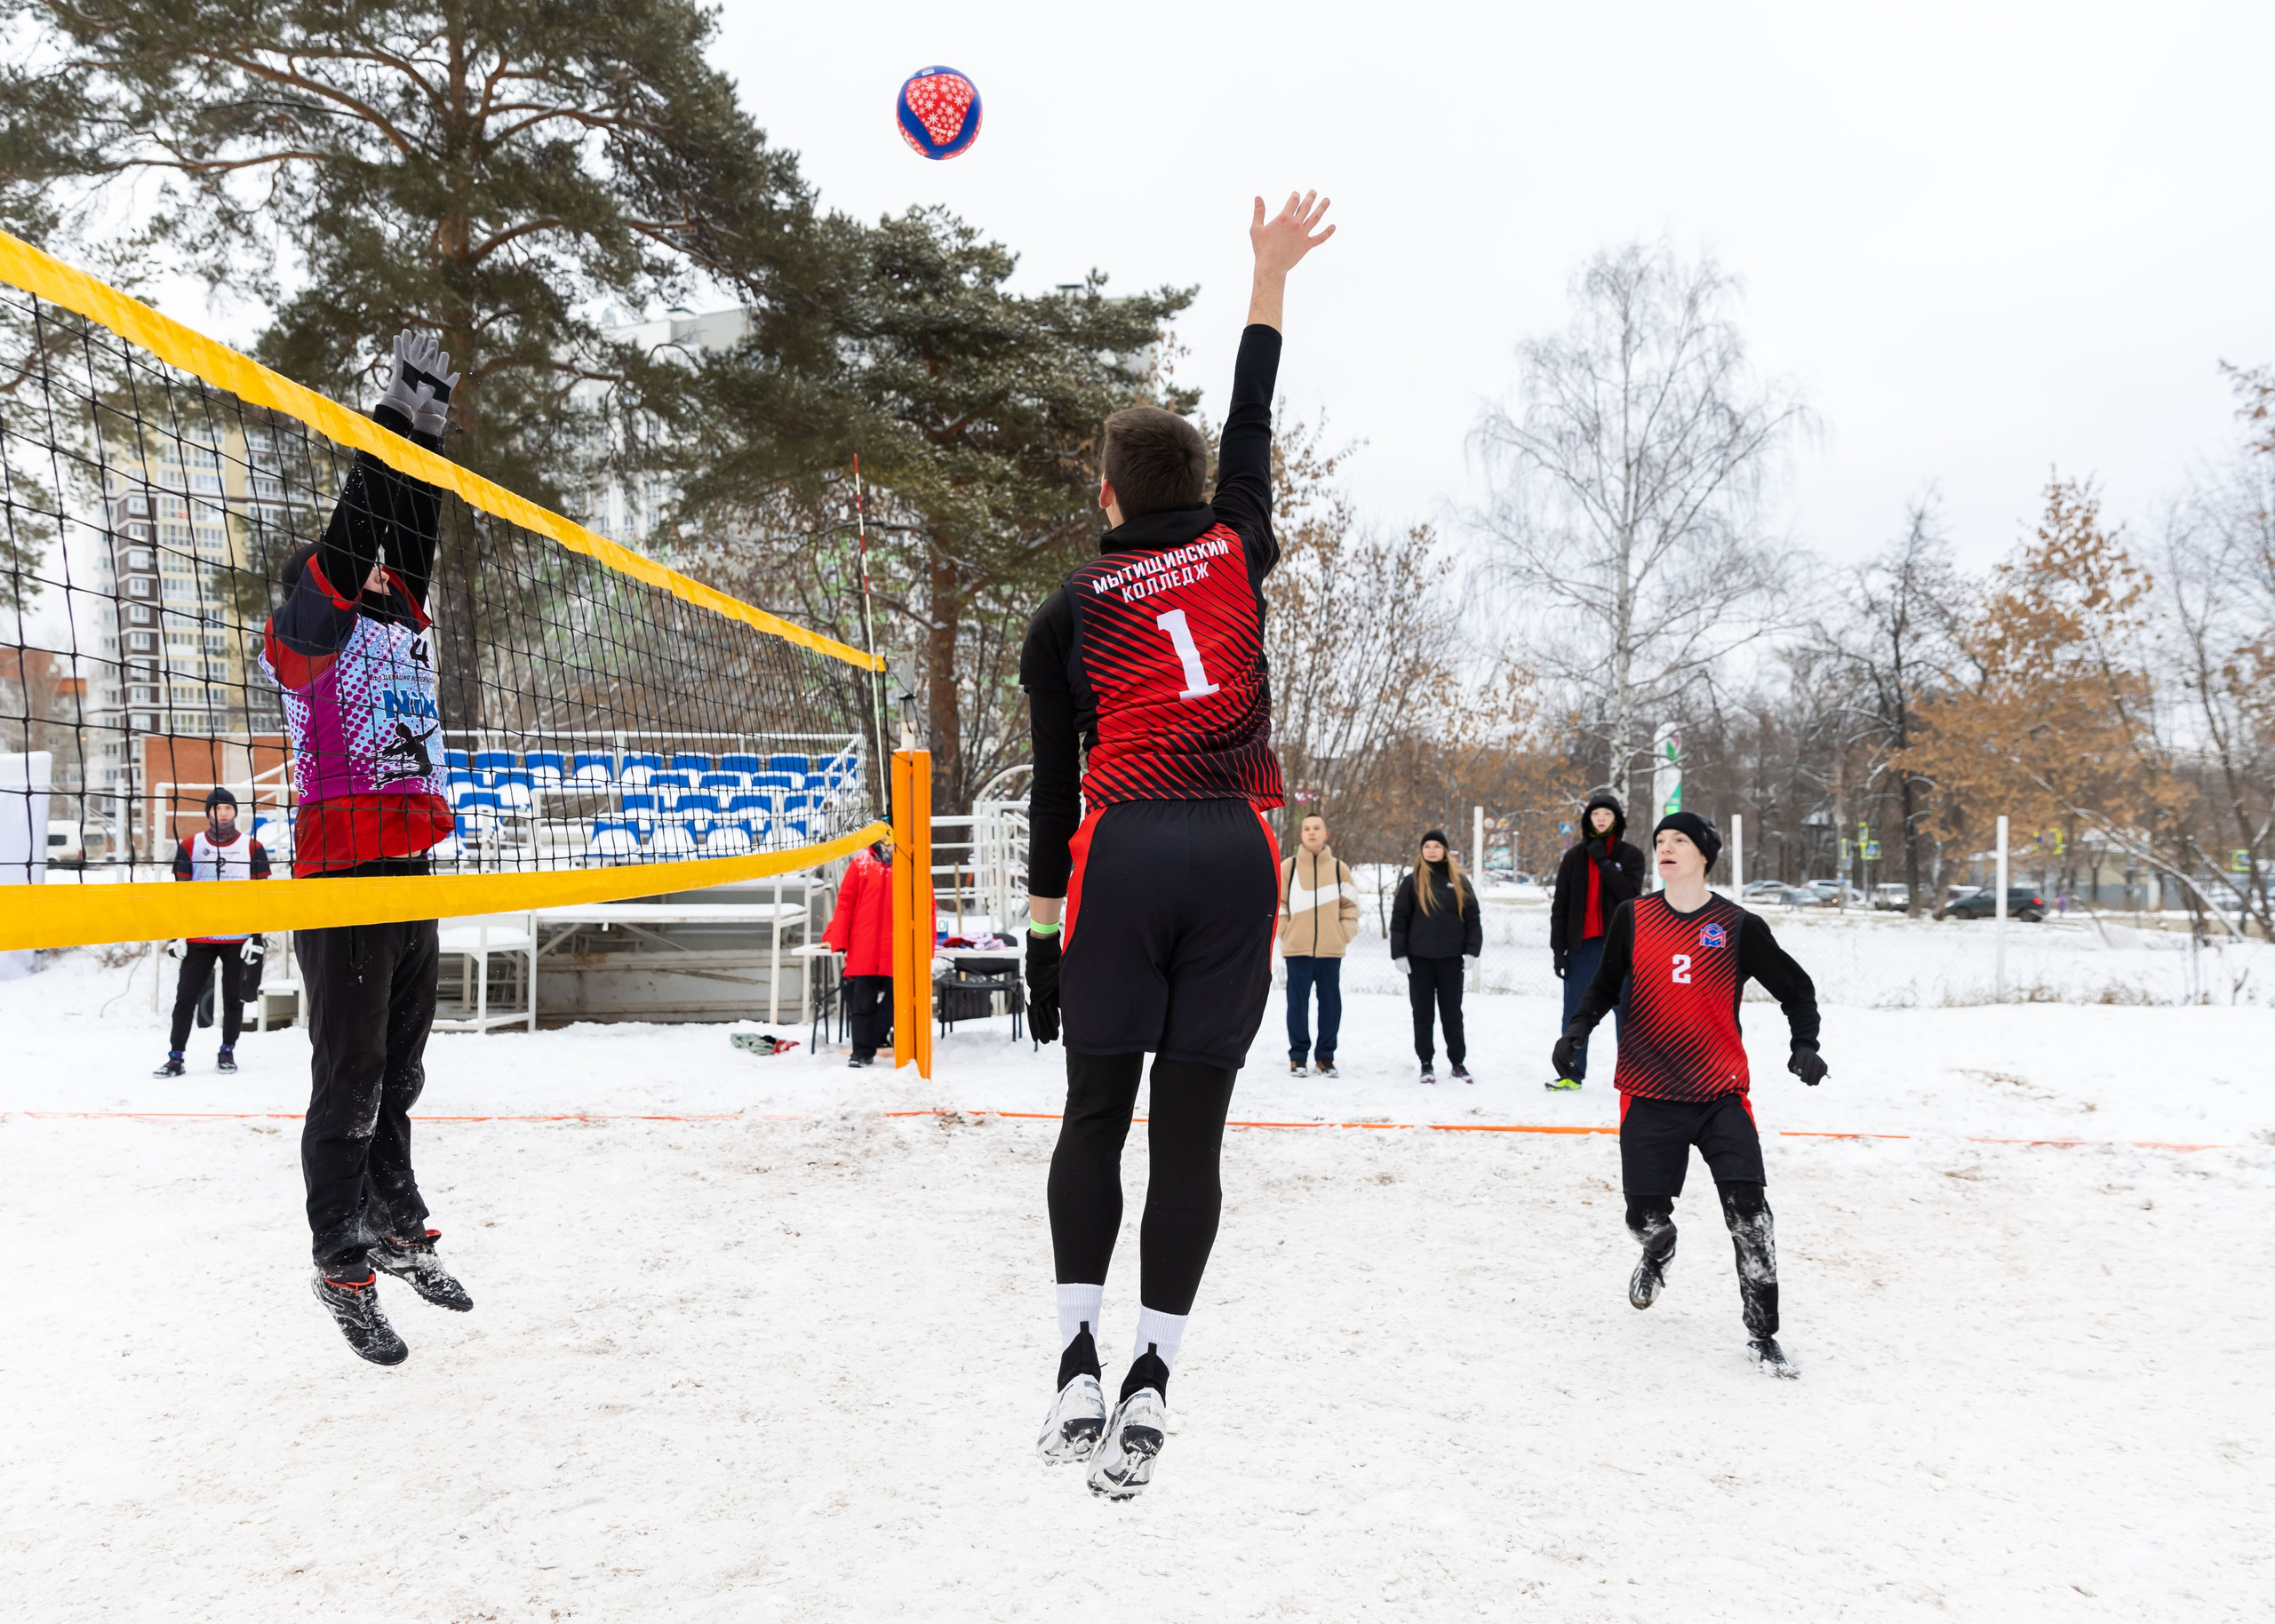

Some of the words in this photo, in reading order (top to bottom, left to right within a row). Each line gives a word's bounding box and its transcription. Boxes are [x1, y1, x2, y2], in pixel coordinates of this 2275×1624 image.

[1092, 537, 1230, 595] МЫТИЩИНСКИЙ
[1122, 561, 1209, 604] КОЛЛЕДЖ
[410, 636, 431, 669] 4
[1156, 609, 1221, 701] 1
[1672, 953, 1692, 984] 2
